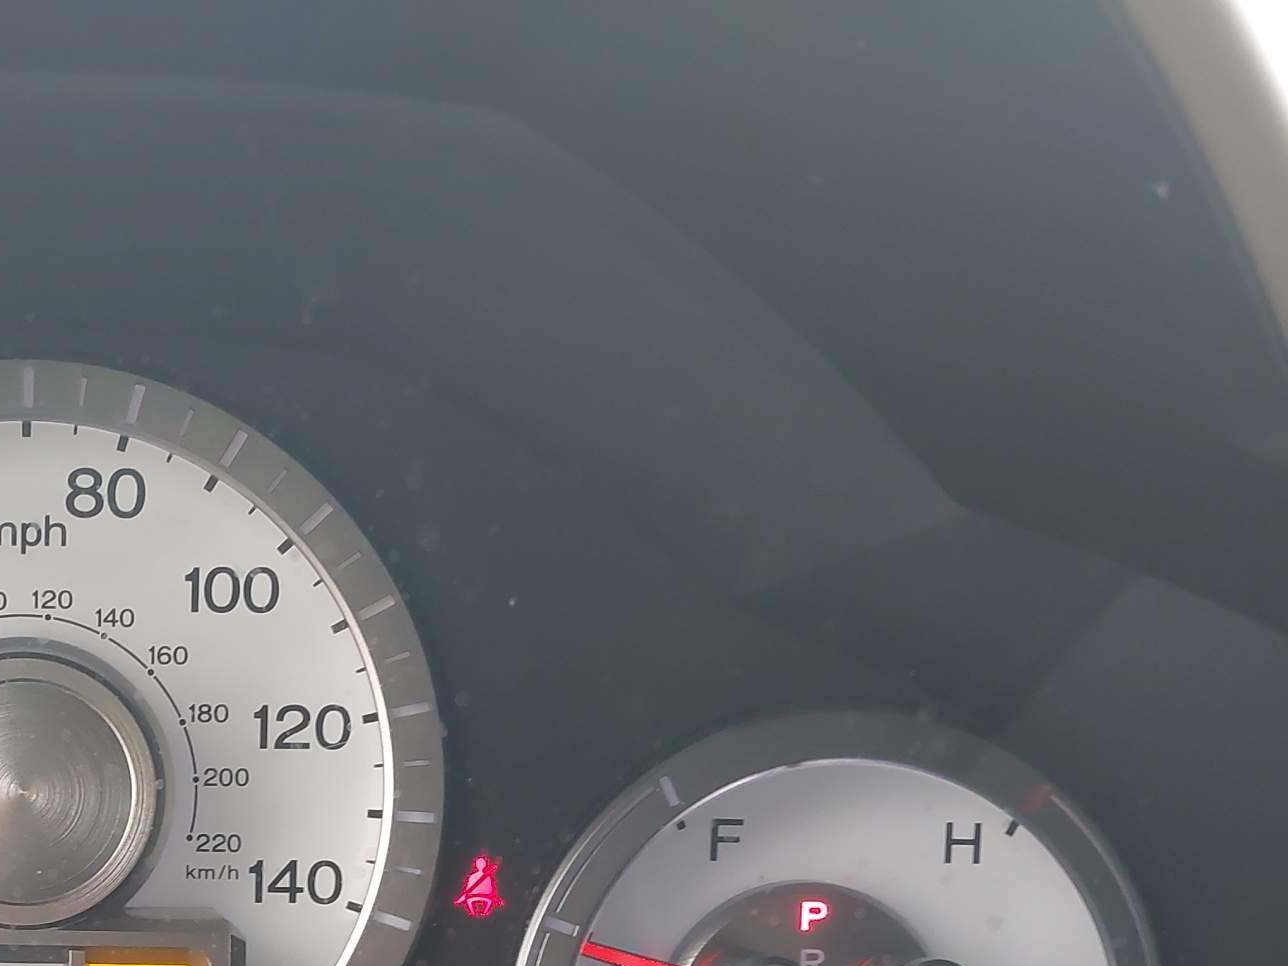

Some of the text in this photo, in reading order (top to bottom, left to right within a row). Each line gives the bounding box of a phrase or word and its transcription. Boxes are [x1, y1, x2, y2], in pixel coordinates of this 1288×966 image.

[66, 468, 145, 518] 80
[32, 590, 72, 609] 120
[185, 567, 279, 613] 100
[94, 609, 134, 629] 140
[148, 645, 188, 666] 160
[189, 704, 228, 723] 180
[254, 705, 351, 750] 120
[204, 768, 248, 786] 200
[196, 834, 241, 852] 220
[710, 819, 744, 861] F
[945, 822, 981, 864] H
[186, 865, 238, 879] km/h
[249, 860, 342, 904] 140
[799, 901, 828, 931] P
